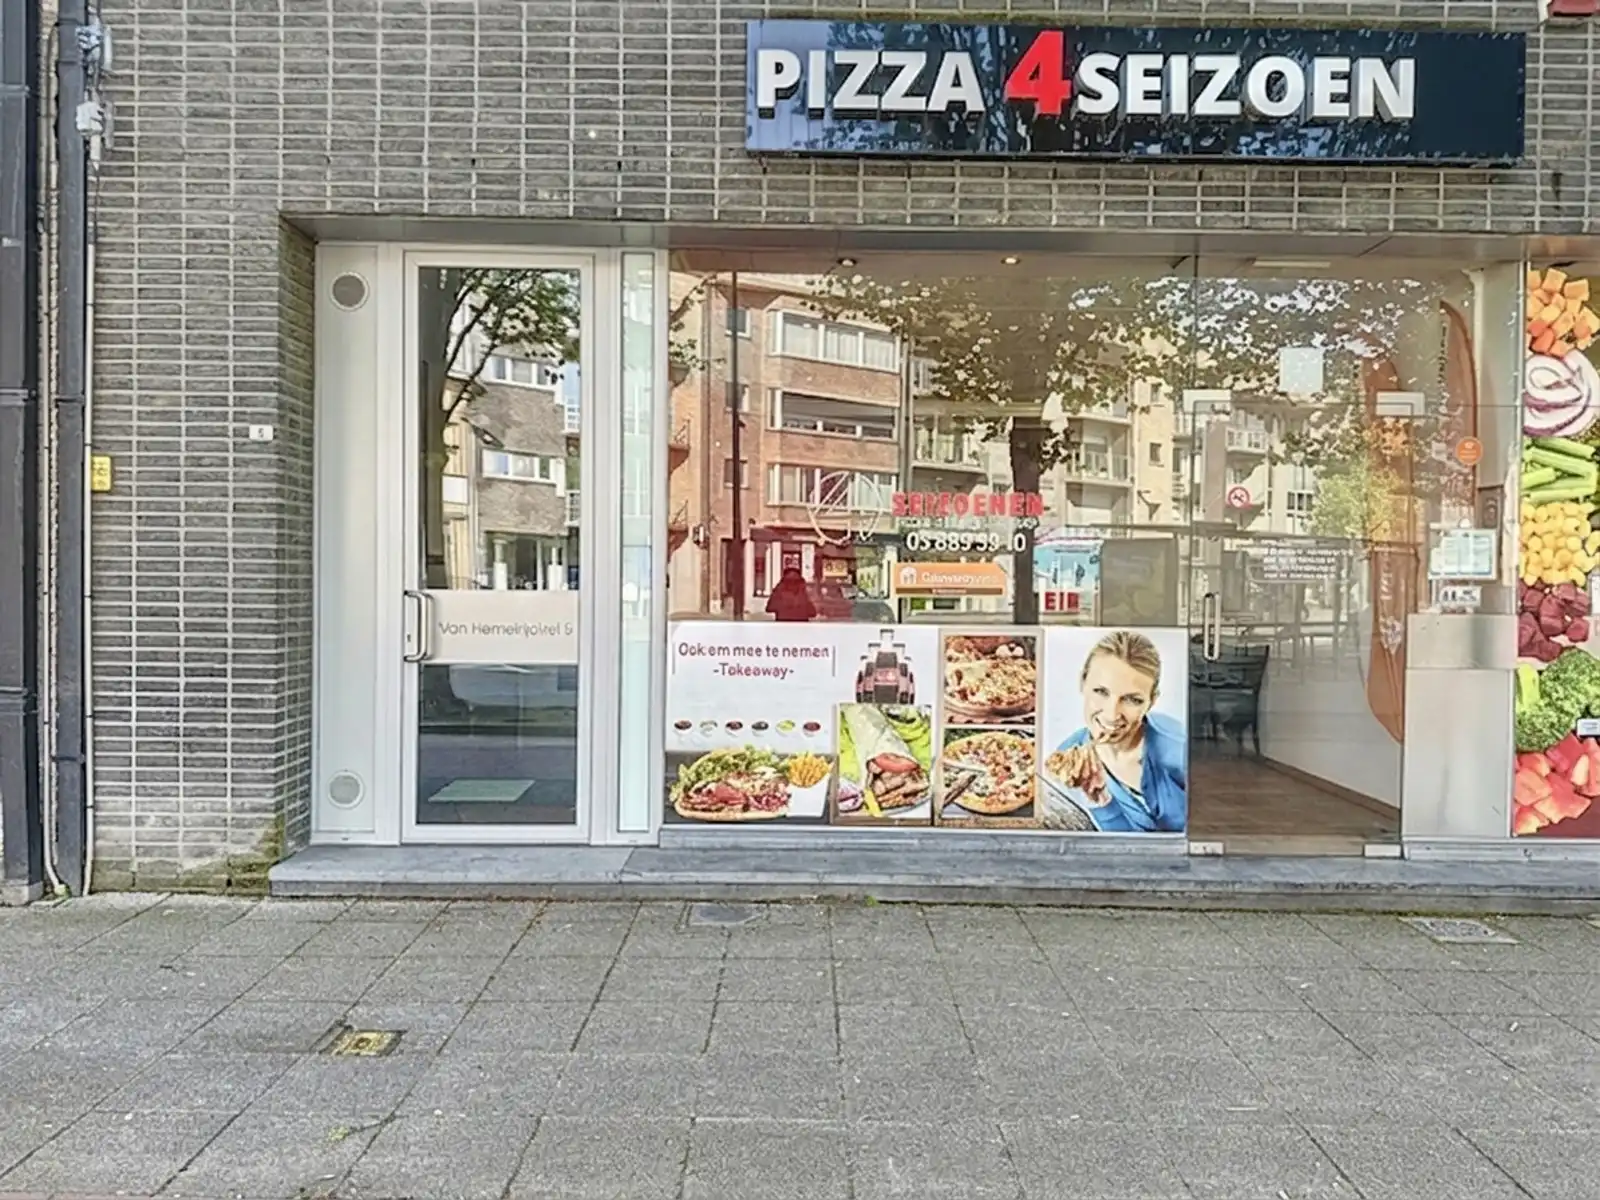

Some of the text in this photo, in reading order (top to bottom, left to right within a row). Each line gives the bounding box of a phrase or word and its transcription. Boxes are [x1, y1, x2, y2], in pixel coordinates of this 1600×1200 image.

[757, 49, 985, 115] PIZZA
[1075, 52, 1416, 119] SEIZOEN
[933, 531, 971, 552] 889
[438, 621, 468, 636] Van
[678, 642, 704, 657] Ook
[733, 646, 763, 658] mee
[766, 645, 779, 658] te
[782, 646, 830, 658] nemen
